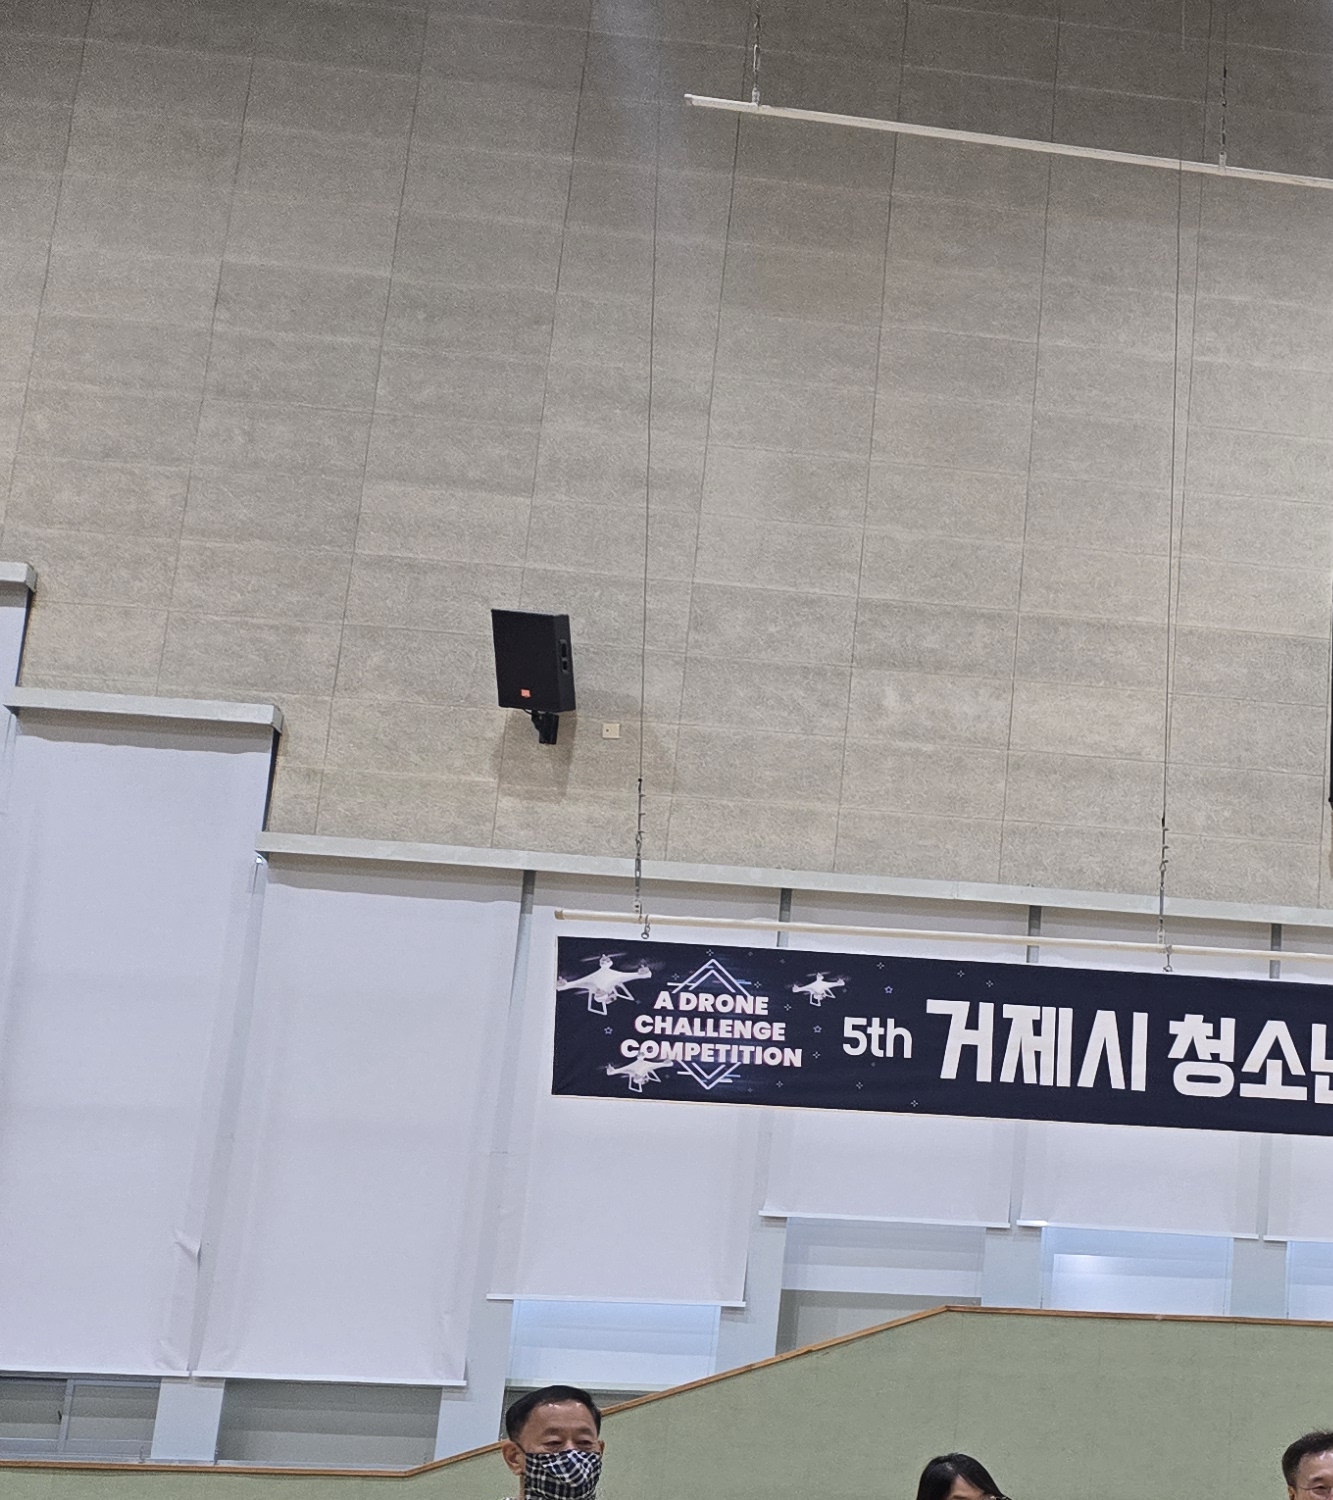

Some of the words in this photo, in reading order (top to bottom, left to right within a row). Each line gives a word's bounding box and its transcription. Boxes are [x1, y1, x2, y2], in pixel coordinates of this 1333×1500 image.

[653, 990, 675, 1011] A
[678, 992, 769, 1016] DRONE
[634, 1014, 787, 1042] CHALLENGE
[620, 1038, 803, 1068] COMPETITION
[841, 1016, 914, 1060] 5th
[925, 998, 1149, 1092] 거제시
